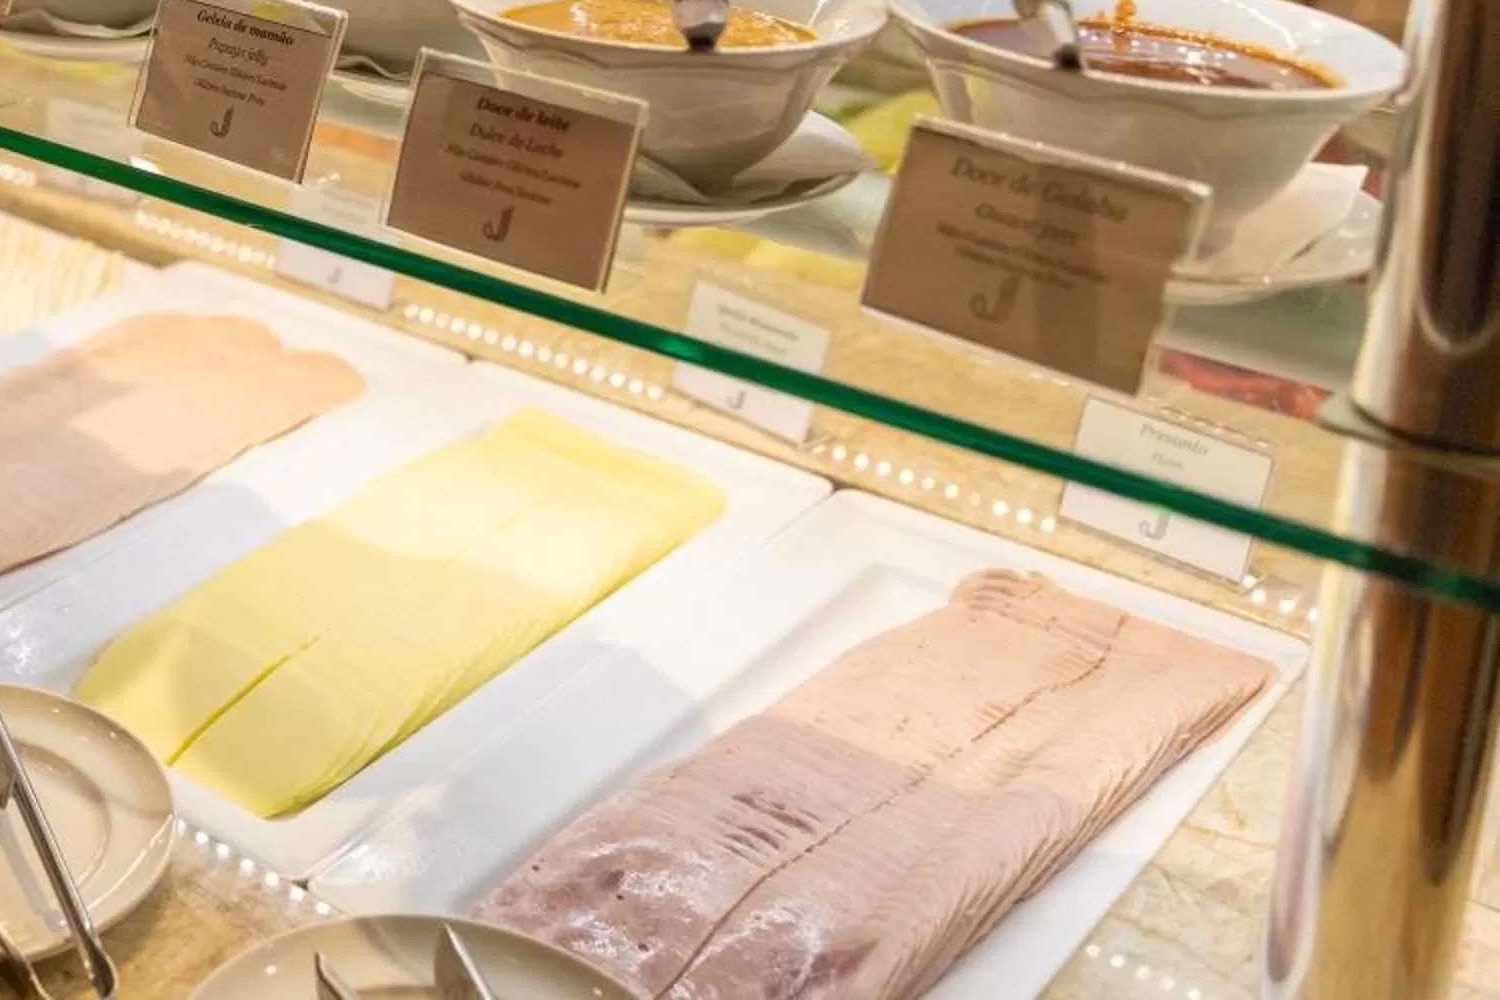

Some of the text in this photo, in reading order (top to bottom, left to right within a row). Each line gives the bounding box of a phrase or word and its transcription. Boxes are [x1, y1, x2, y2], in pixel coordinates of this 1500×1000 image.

[198, 9, 232, 31] Geleia
[234, 19, 247, 34] de
[515, 106, 535, 122] de
